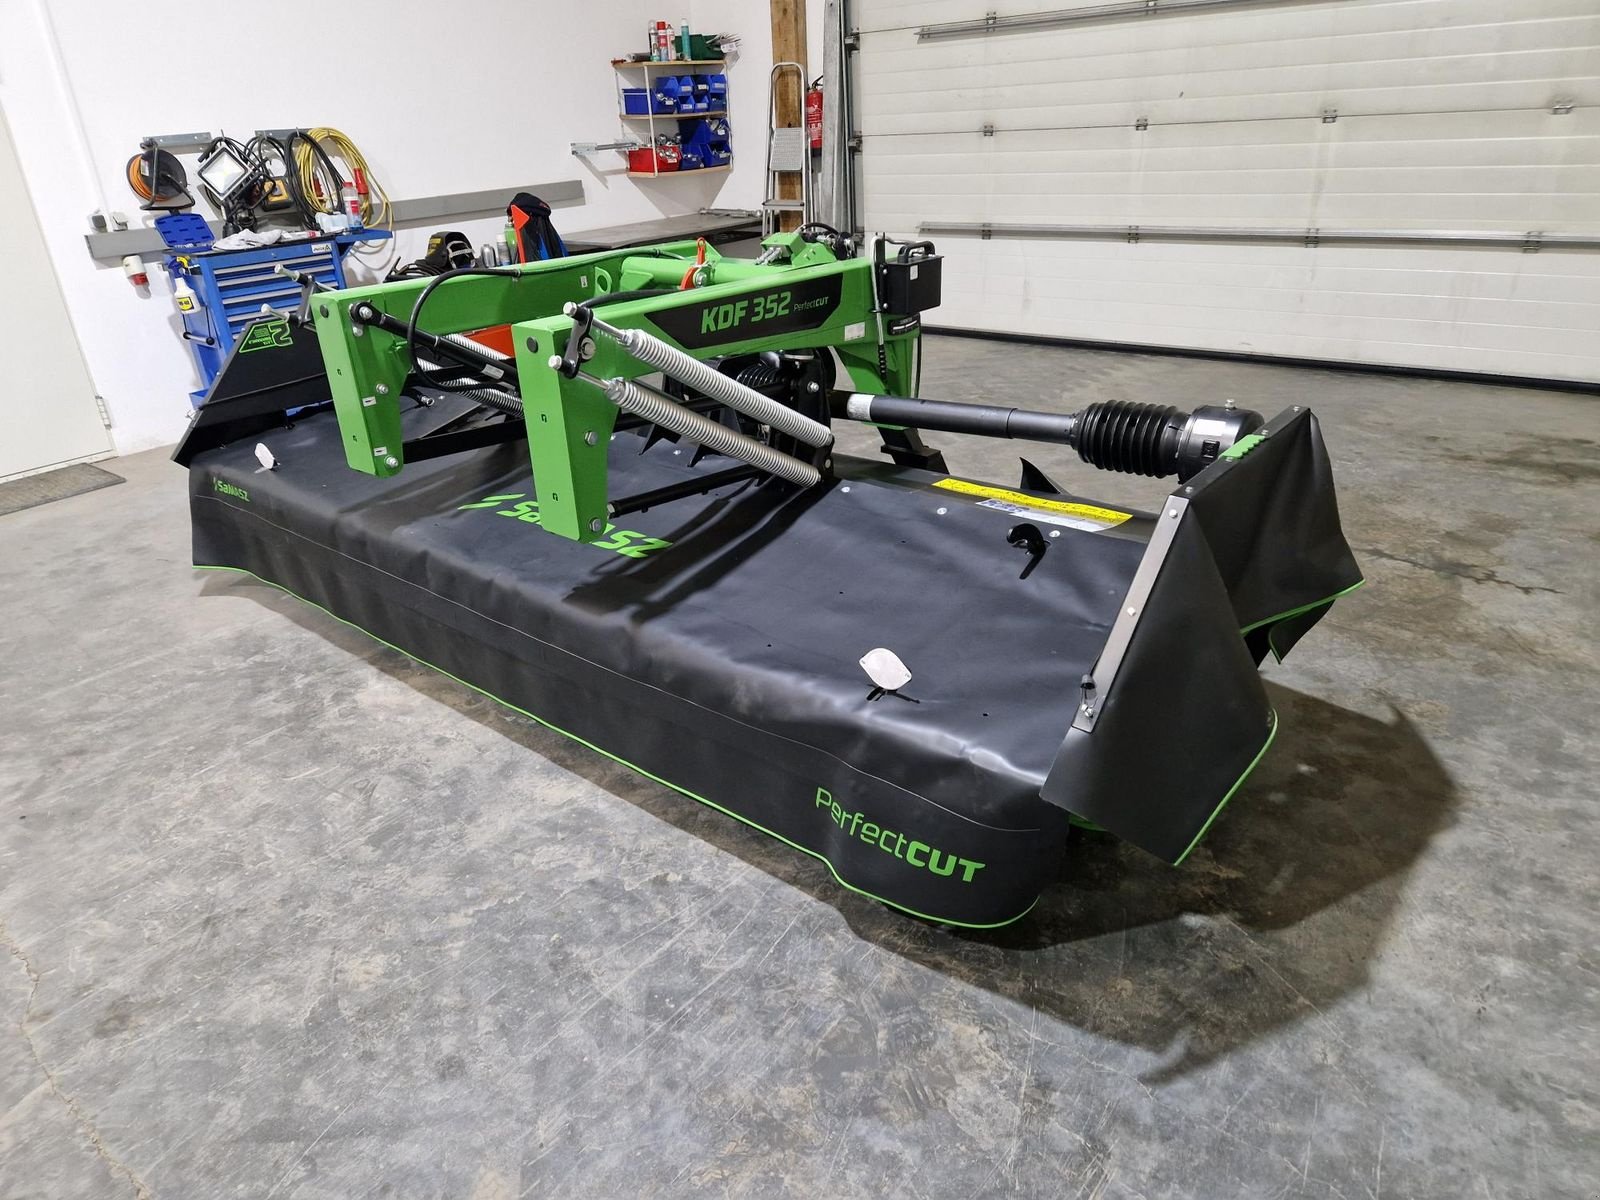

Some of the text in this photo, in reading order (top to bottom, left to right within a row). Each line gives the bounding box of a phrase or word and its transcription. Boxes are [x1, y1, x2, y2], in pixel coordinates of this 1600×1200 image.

[701, 291, 829, 334] KDF 352 PerfectCUT
[496, 501, 673, 558] SaSZ
[814, 786, 987, 883] PerfectCUT
